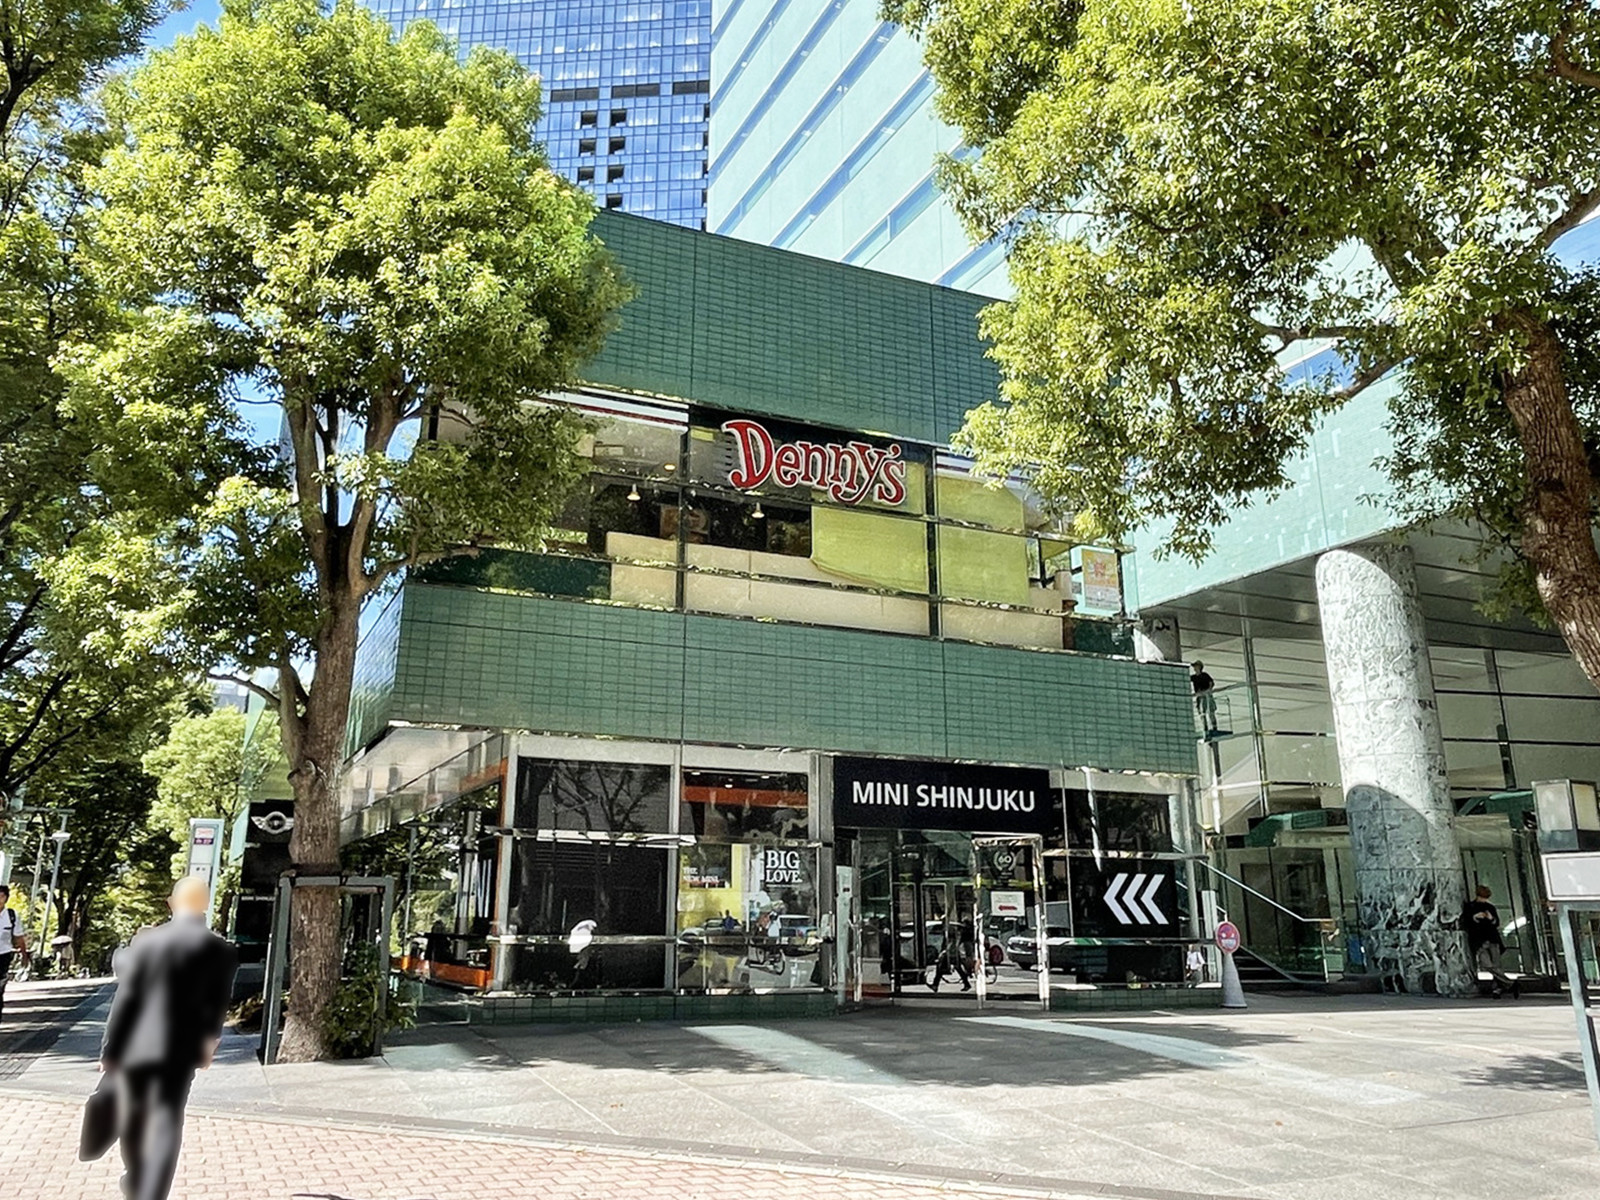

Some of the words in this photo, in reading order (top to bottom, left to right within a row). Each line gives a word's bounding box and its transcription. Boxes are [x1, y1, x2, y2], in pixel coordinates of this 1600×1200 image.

[721, 419, 906, 506] Denny's
[852, 781, 908, 806] MINI
[916, 784, 1035, 812] SHINJUKU
[765, 850, 800, 869] BIG
